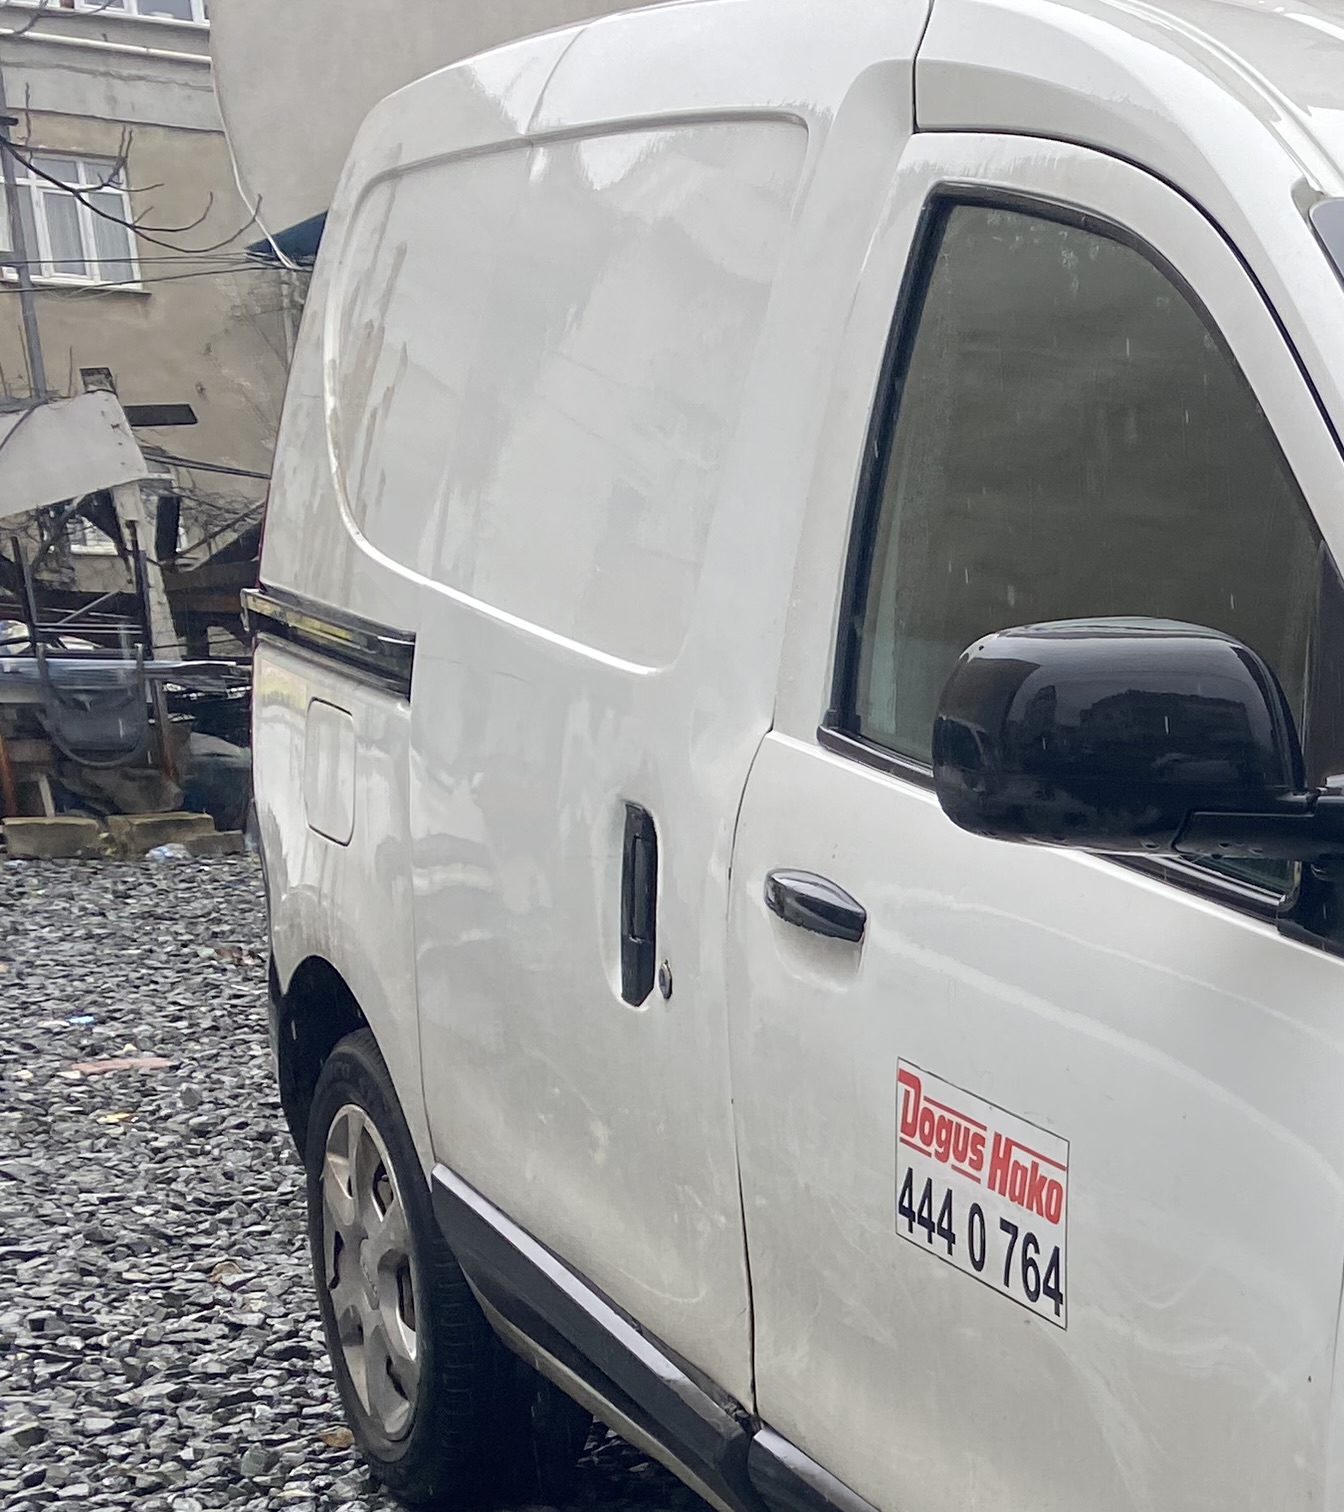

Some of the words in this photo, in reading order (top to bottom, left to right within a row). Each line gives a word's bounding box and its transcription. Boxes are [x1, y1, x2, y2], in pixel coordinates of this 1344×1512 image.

[897, 1067, 986, 1172] Dogus
[987, 1131, 1064, 1225] Hako
[898, 1166, 956, 1257] 444
[968, 1202, 986, 1273] 0
[999, 1216, 1064, 1317] 764
